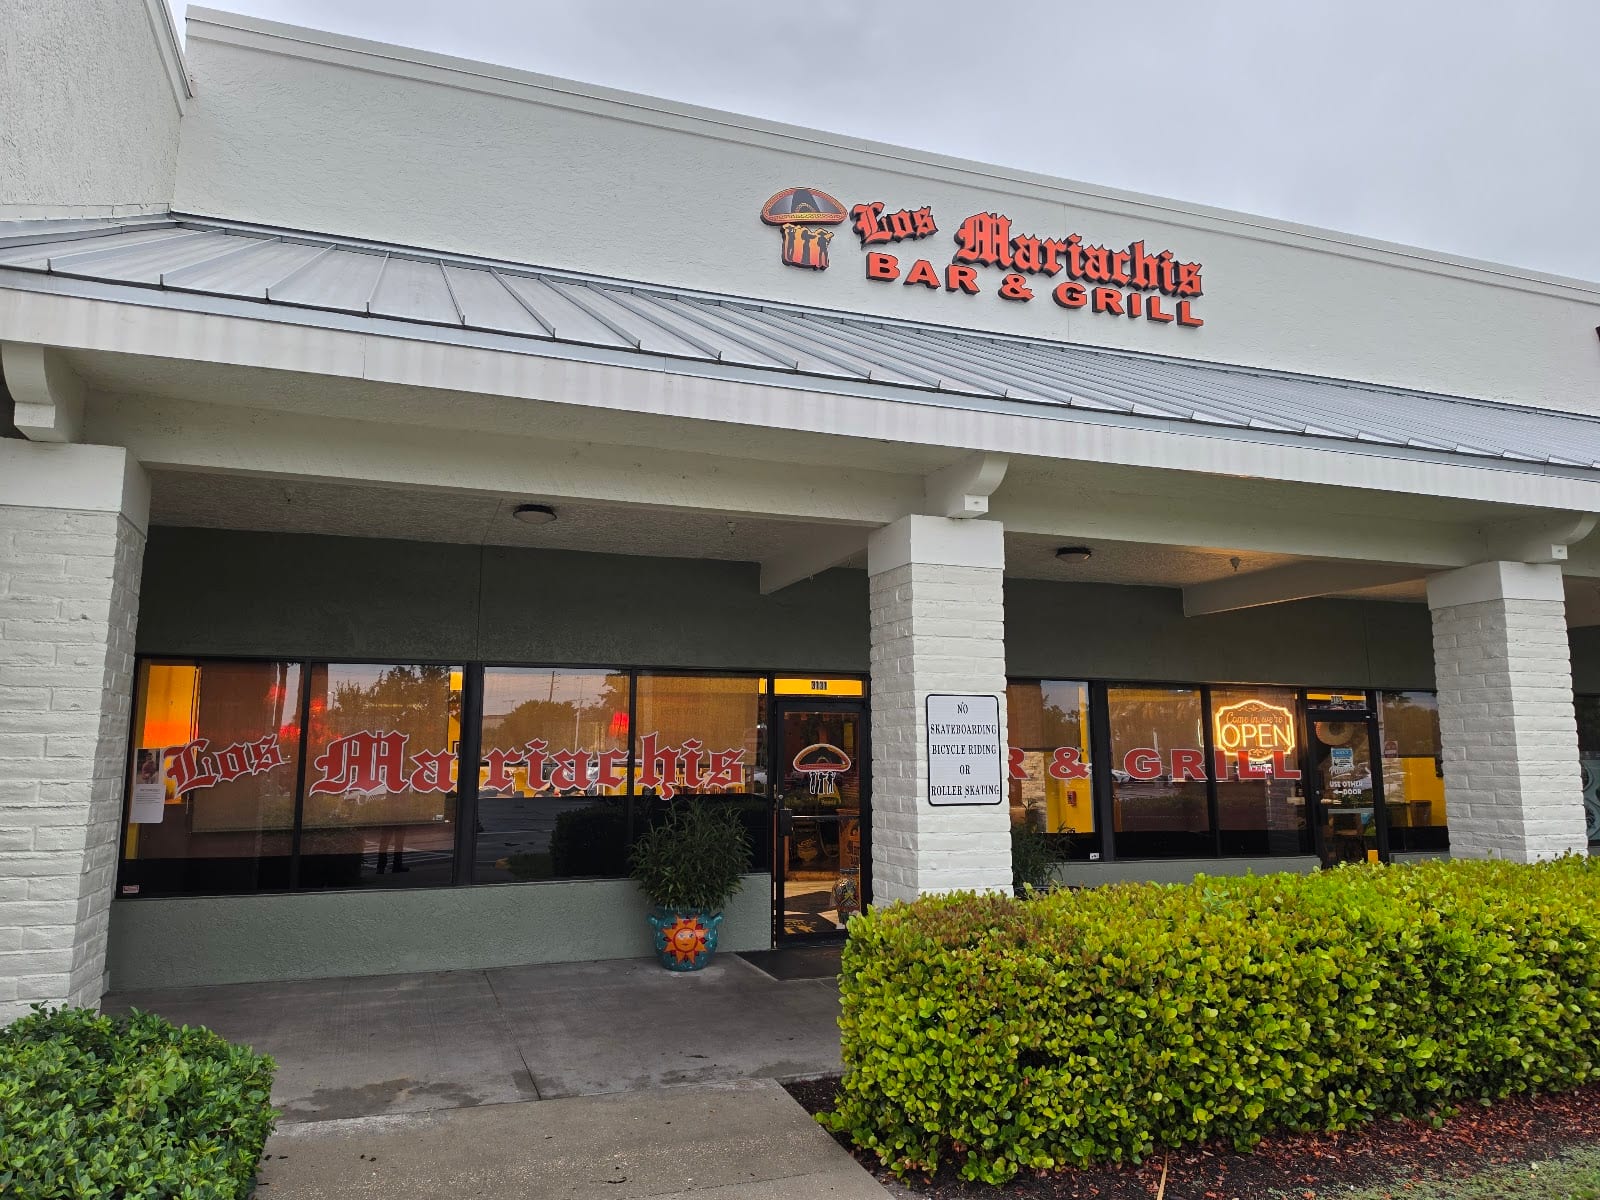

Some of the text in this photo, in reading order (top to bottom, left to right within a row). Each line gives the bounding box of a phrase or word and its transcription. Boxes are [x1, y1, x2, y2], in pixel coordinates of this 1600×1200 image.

[851, 202, 1204, 297] Los Mariachis
[866, 252, 1204, 328] BAR & GRILL
[957, 704, 969, 714] NO
[930, 724, 997, 735] SKATEBOARDING
[1221, 723, 1292, 748] OPEN
[931, 744, 997, 755] BICYCLE RIDING
[163, 730, 746, 801] Los Mariachis
[959, 765, 971, 775] OR
[1049, 746, 1091, 780] &
[1123, 747, 1302, 780] GRILL
[931, 785, 1000, 796] ROLLER SKATING
